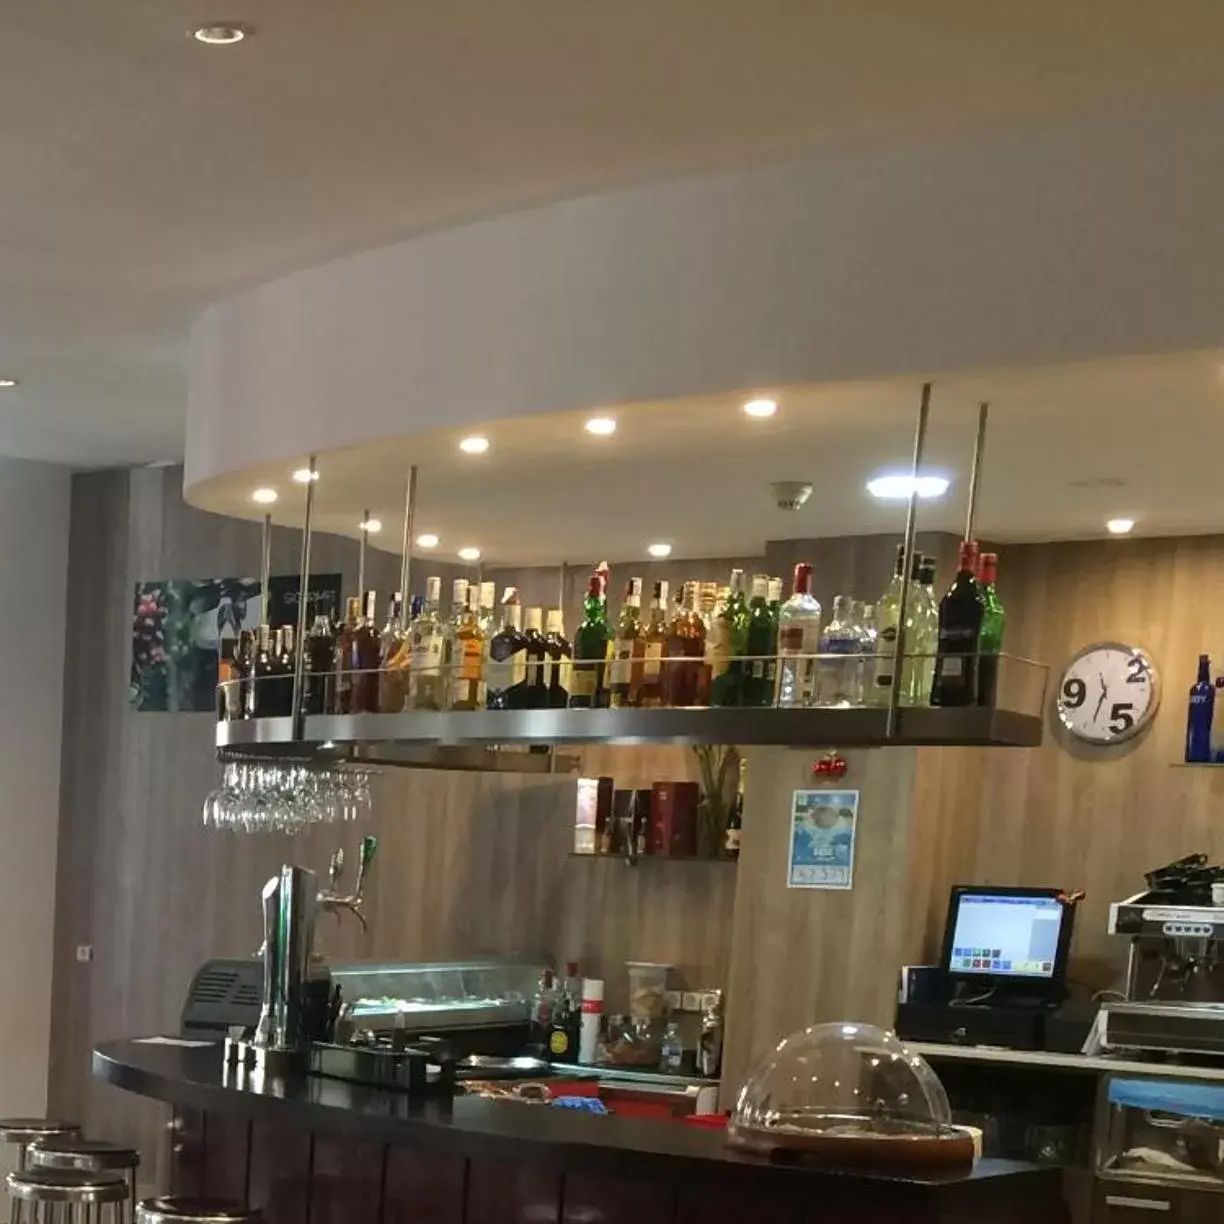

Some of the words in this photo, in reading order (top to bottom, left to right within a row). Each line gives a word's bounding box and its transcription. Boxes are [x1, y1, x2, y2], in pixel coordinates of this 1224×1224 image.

[1126, 657, 1146, 683] 2
[1063, 678, 1087, 709] 9
[1109, 703, 1134, 734] 5
